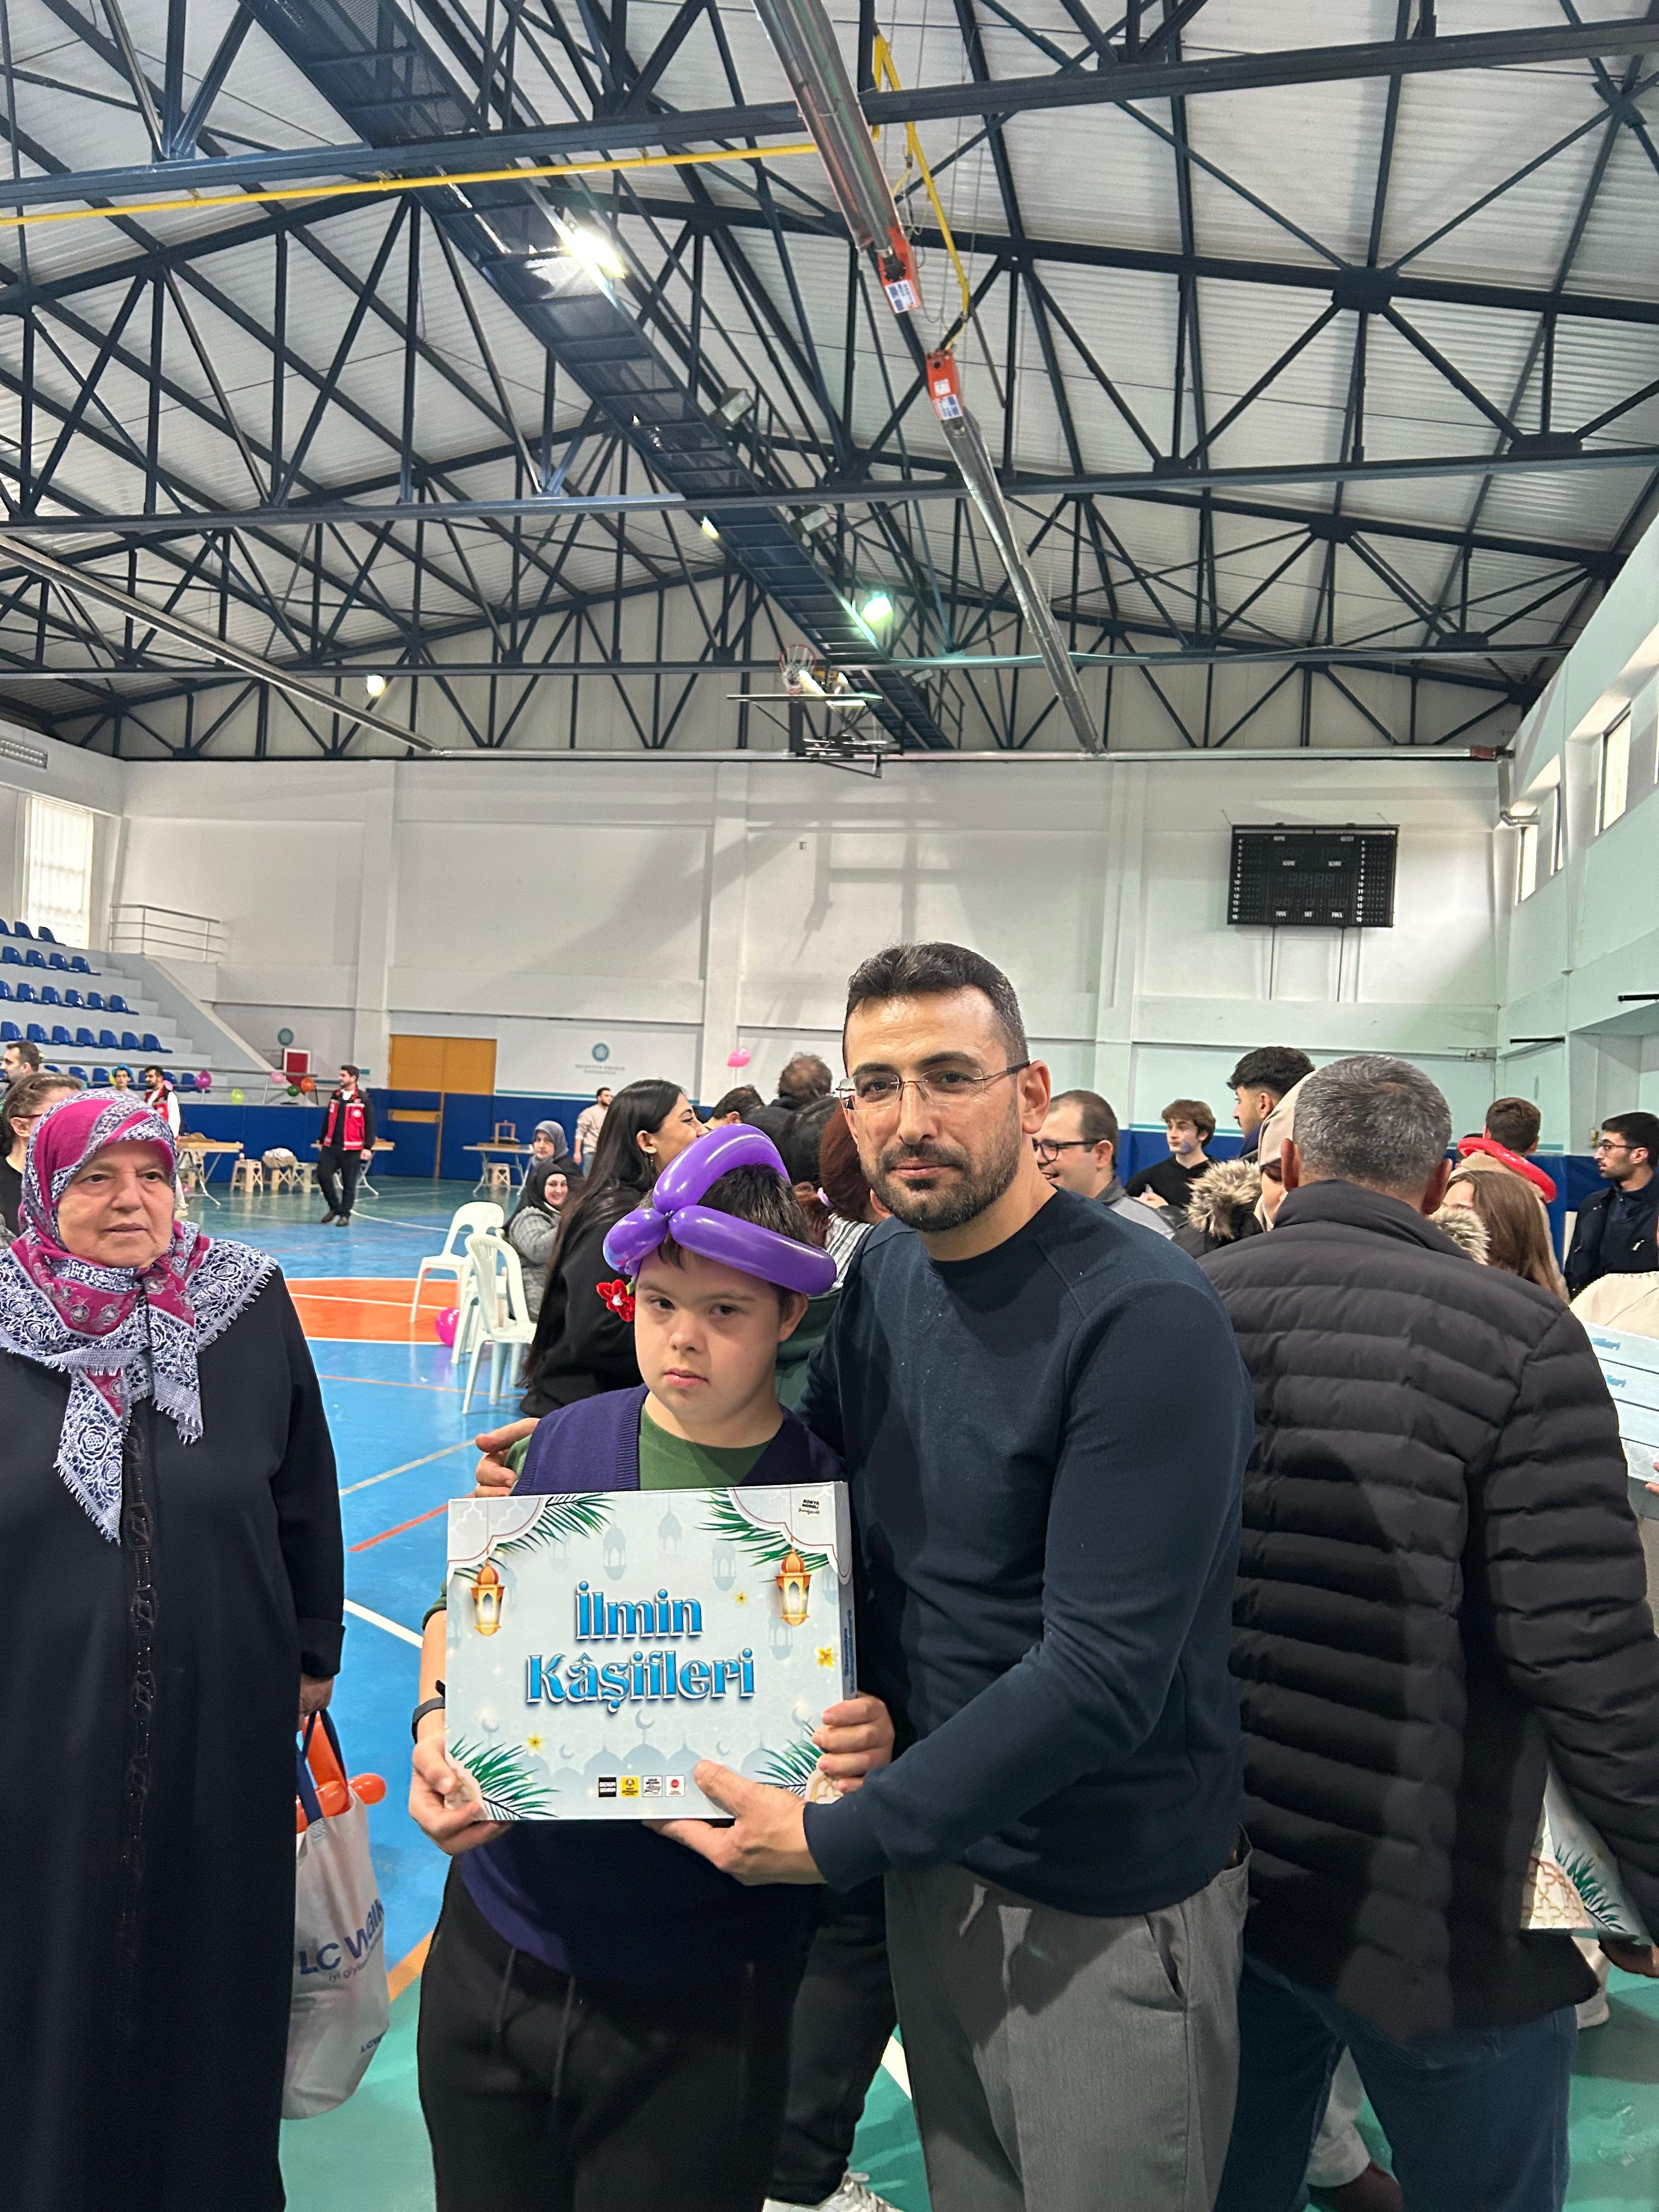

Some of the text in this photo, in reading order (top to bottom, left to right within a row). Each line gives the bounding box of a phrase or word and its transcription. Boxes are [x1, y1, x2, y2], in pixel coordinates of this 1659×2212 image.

[575, 1581, 703, 1639] İlmin
[527, 1648, 755, 1713] Kâşifleri
[300, 1943, 341, 1975] LC
